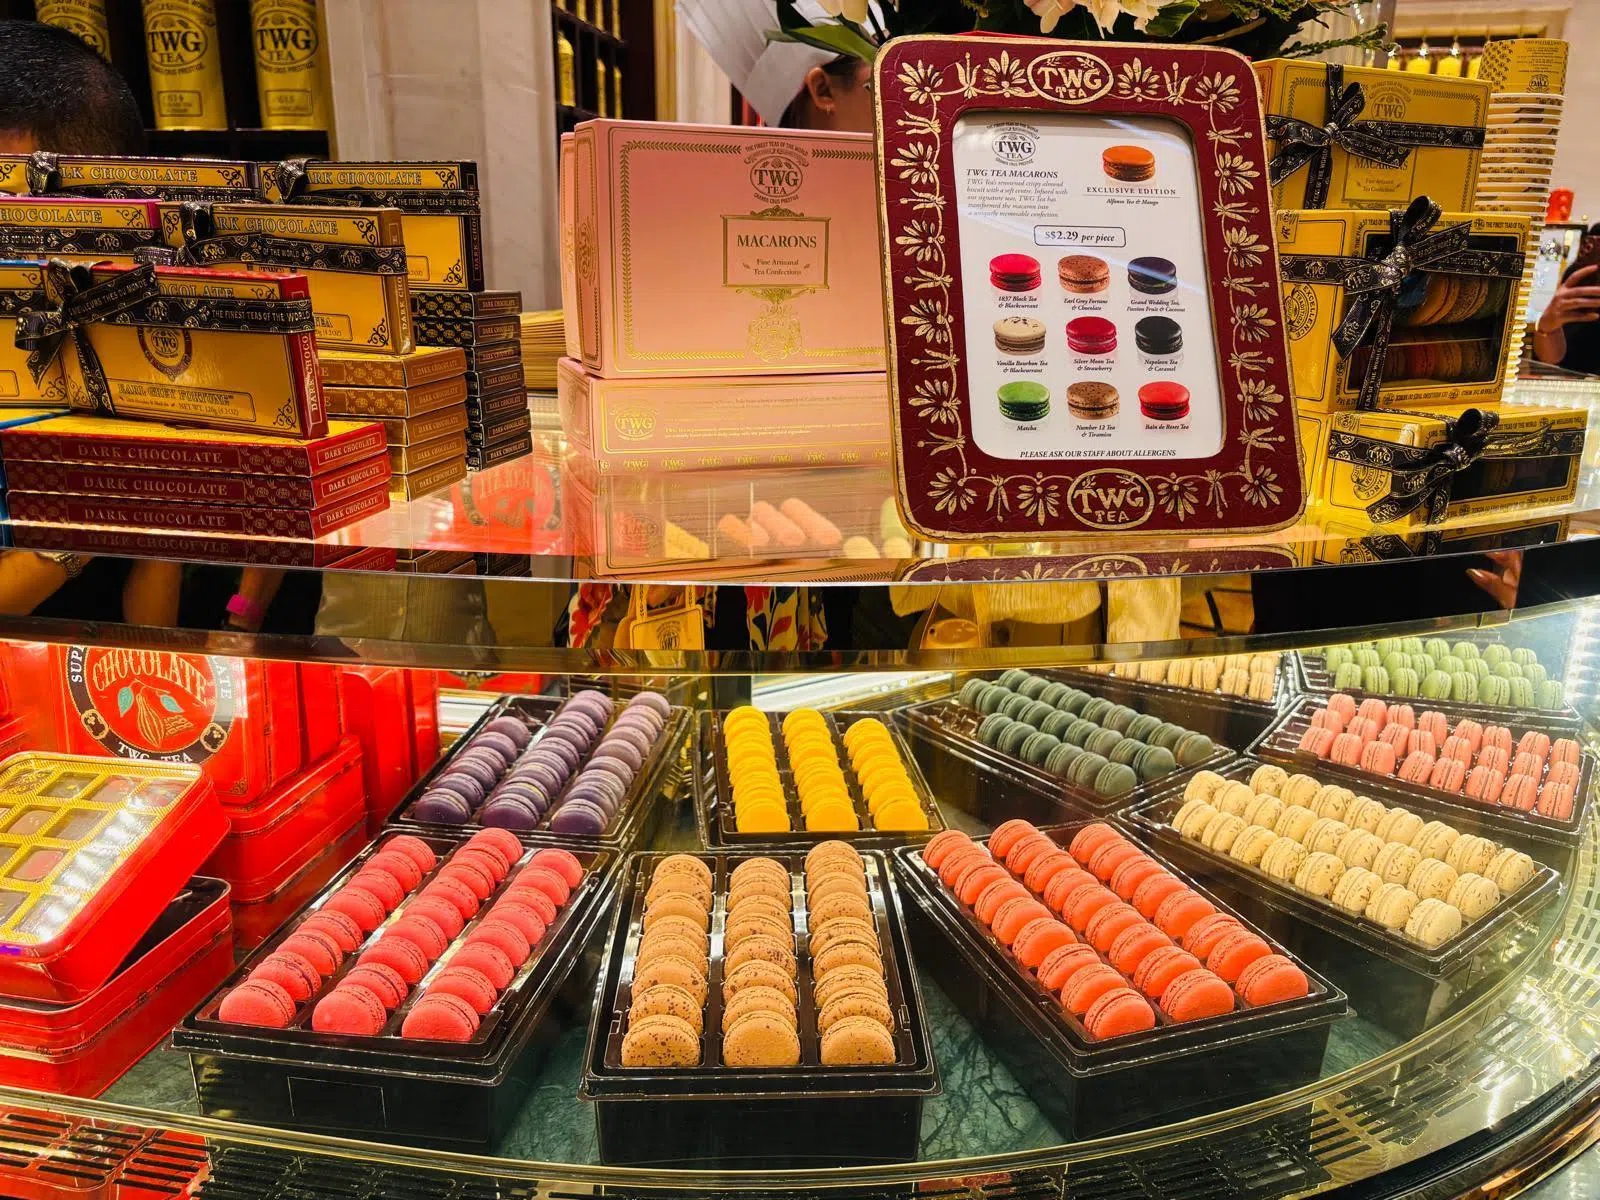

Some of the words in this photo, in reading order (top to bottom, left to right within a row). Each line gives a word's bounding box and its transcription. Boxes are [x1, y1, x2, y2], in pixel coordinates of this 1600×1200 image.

[147, 31, 201, 52] TWG
[256, 28, 311, 51] TWG
[159, 53, 185, 64] TEA
[268, 51, 295, 61] TEA
[1036, 66, 1102, 90] TWG
[1055, 86, 1087, 99] TEA
[1373, 103, 1403, 119] TWG
[994, 140, 1033, 154] TWG
[90, 167, 198, 182] CHOCOLATE
[306, 172, 334, 184] ARK
[337, 172, 422, 185] CHOCOLATE
[754, 169, 800, 187] TWG
[966, 168, 988, 177] TWG
[990, 169, 1007, 177] TEA
[1009, 170, 1059, 179] MACARONS
[766, 186, 787, 195] TEA
[1086, 186, 1135, 194] EXCLUSIVE
[0, 208, 102, 223] HOCOLATE
[244, 218, 339, 235] CHOCOLATE
[737, 234, 817, 249] MACARONS
[1045, 230, 1079, 240] S$2.29
[1081, 234, 1095, 243] per
[1096, 234, 1115, 243] piece
[212, 310, 223, 318] THE
[224, 310, 246, 319] FINEST
[247, 311, 263, 320] TEAS
[272, 311, 285, 321] THE
[287, 311, 311, 321] WORLD
[401, 301, 409, 331] DARK
[1294, 285, 1316, 339] EXCELLENCE
[152, 335, 178, 349] TWG
[417, 367, 431, 376] DARK
[431, 360, 458, 371] CHOCOLATE
[486, 377, 498, 385] DARK
[498, 373, 518, 382] CHOCOLATE
[306, 375, 318, 412] DARK
[419, 393, 432, 402] DARK
[432, 386, 458, 399] CHOCOLATE
[489, 401, 500, 409] DARK
[500, 397, 521, 407] CHOCOLATE
[418, 424, 431, 433] DARK
[432, 416, 459, 429] CHOCOLATE
[492, 425, 504, 435] DARK
[503, 420, 524, 431] CHOCOLATE
[617, 417, 653, 430] TWG
[78, 444, 121, 457] DARK
[128, 447, 223, 464] CHOCOLATE
[324, 447, 343, 460] DARK
[343, 437, 376, 454] CHOCOLATE
[417, 450, 431, 460] DARK
[431, 441, 458, 456] CHOCOLATE
[490, 450, 502, 459] DARK
[503, 442, 525, 455] CHOCOLATE
[1020, 450, 1048, 458] PLEASE
[1048, 450, 1064, 458] ASK
[1065, 450, 1082, 458] OUR
[1082, 450, 1105, 458] STAFF
[1105, 450, 1133, 458] ABOUT
[1133, 449, 1176, 458] ALLERGENS
[1368, 449, 1392, 462] TWG
[328, 480, 346, 492] DARK
[346, 466, 380, 485] CHOCOLATE
[420, 479, 433, 488] DARK
[433, 467, 458, 482] CHOCOLATE
[83, 476, 128, 490] DARK
[133, 479, 228, 496] CHOCOLATE
[1073, 488, 1145, 514] TWG
[84, 508, 129, 521] DARK
[133, 511, 226, 527] CHOCOLATE
[326, 510, 345, 523] DARK
[345, 496, 378, 515] CHOCOLATE
[1095, 509, 1130, 523] TEA
[92, 649, 208, 706] CHOCOLATE
